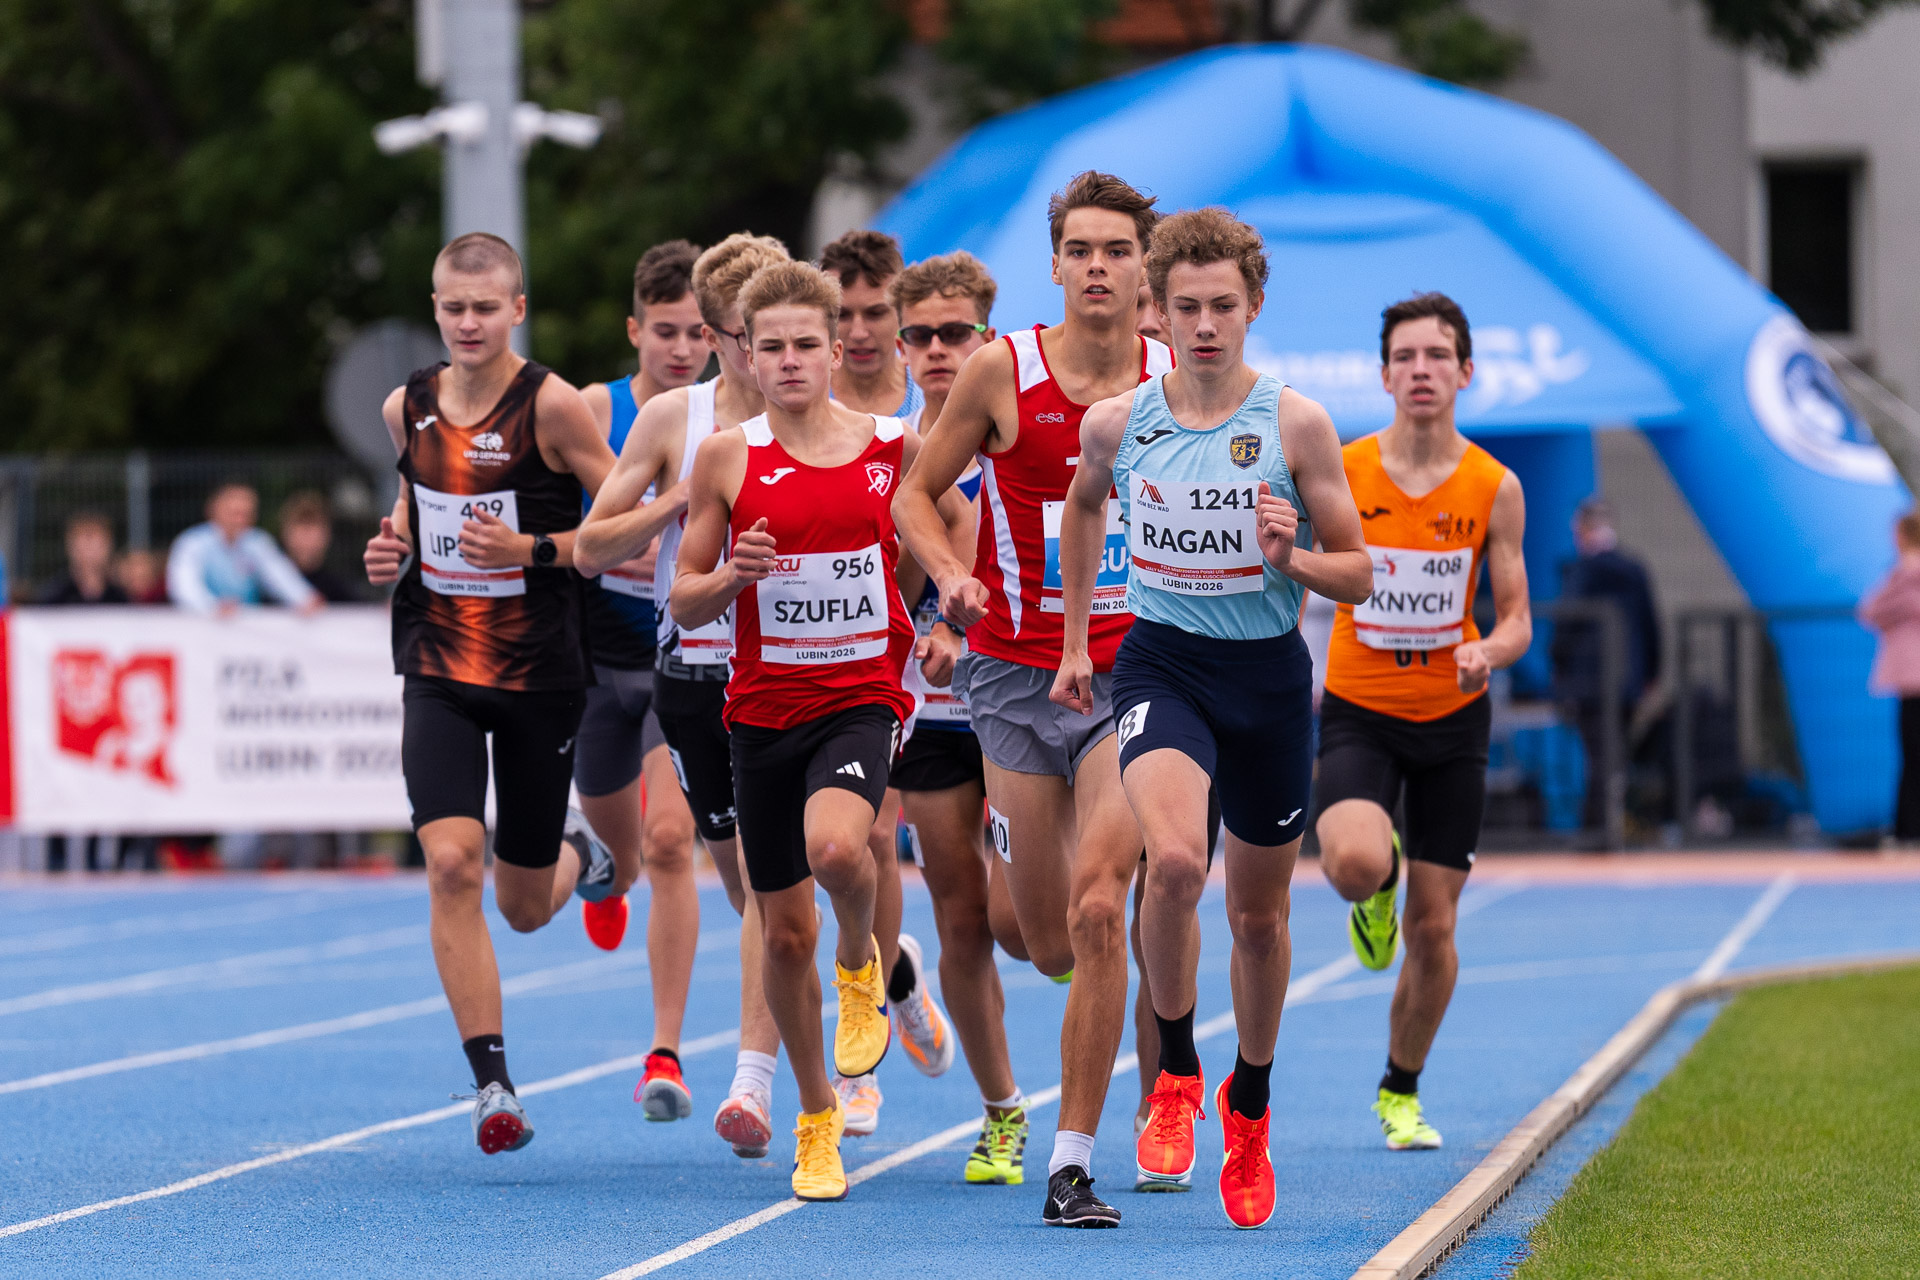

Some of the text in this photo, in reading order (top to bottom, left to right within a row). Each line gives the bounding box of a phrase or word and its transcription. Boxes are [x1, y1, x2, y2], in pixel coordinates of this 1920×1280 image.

[1036, 413, 1065, 423] esa
[1136, 499, 1170, 513] DOM BEZ WAD
[1189, 488, 1256, 510] 1241
[1142, 522, 1243, 553] RAGAN
[832, 554, 874, 580] 956
[1422, 556, 1462, 577] 408
[438, 582, 465, 591] LUBIN
[1162, 577, 1224, 591] LUBIN 2026
[774, 595, 874, 624] SZUFLA
[1370, 590, 1453, 613] KNYCH
[796, 648, 856, 660] LUBIN 2026
[1121, 710, 1137, 746] 8
[991, 815, 1008, 854] 10
